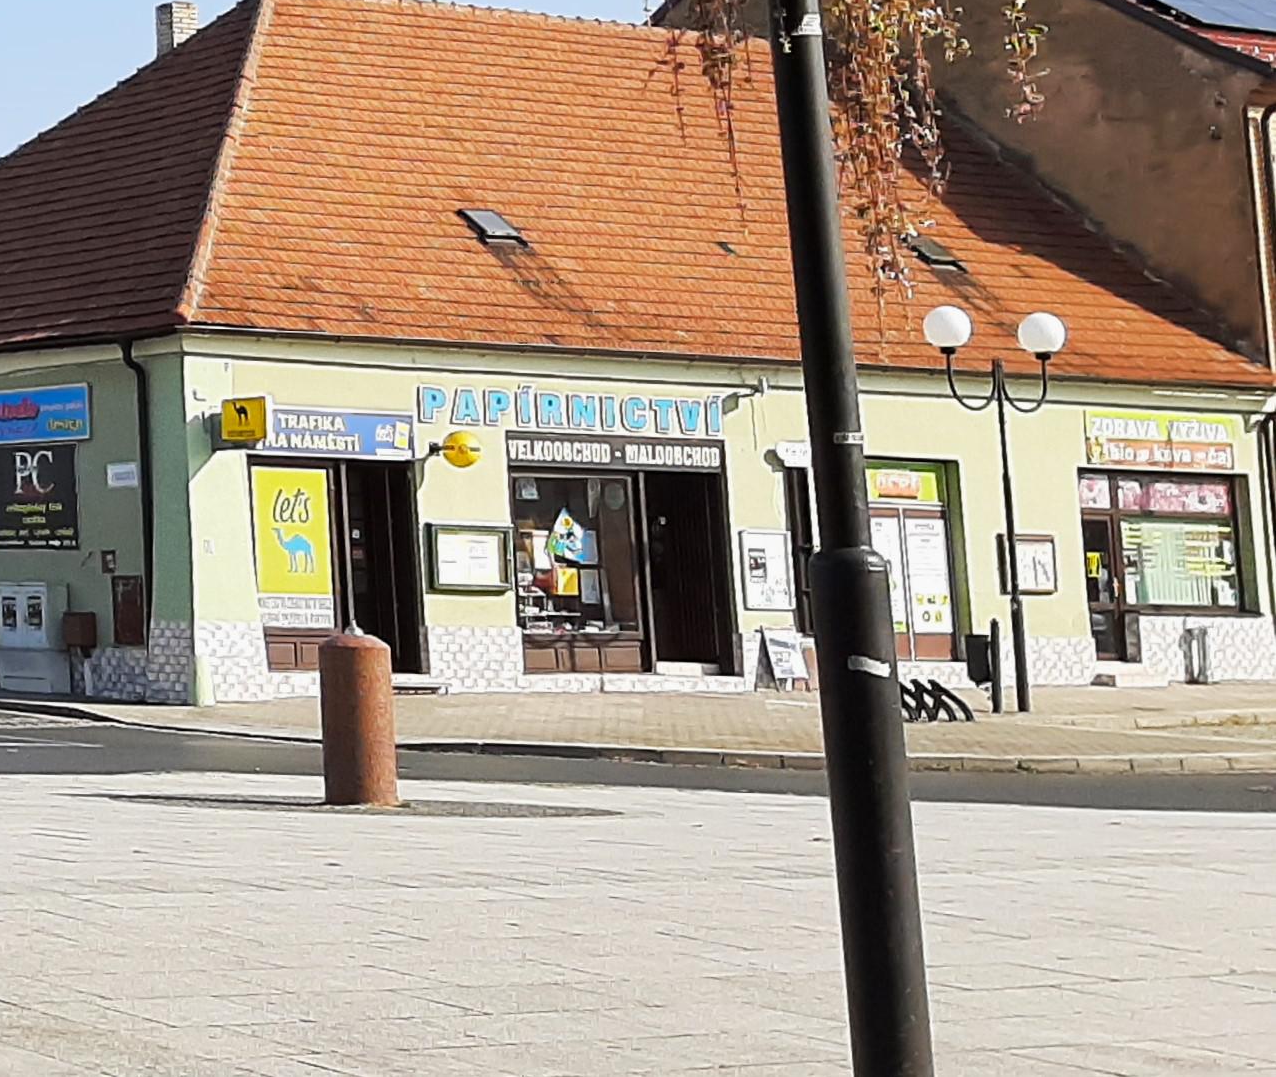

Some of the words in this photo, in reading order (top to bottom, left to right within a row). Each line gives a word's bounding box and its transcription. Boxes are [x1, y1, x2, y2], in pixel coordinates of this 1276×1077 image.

[277, 413, 346, 432] TRAFIKA
[418, 383, 723, 436] PAPÍRNICTVÍ
[265, 433, 288, 448] NA
[290, 432, 360, 452] NÁMĚSTÍ
[507, 439, 612, 464] VELKOOBCHOD
[625, 443, 721, 468] MALOOBCHOD
[13, 450, 55, 494] PC
[272, 488, 311, 524] let's
